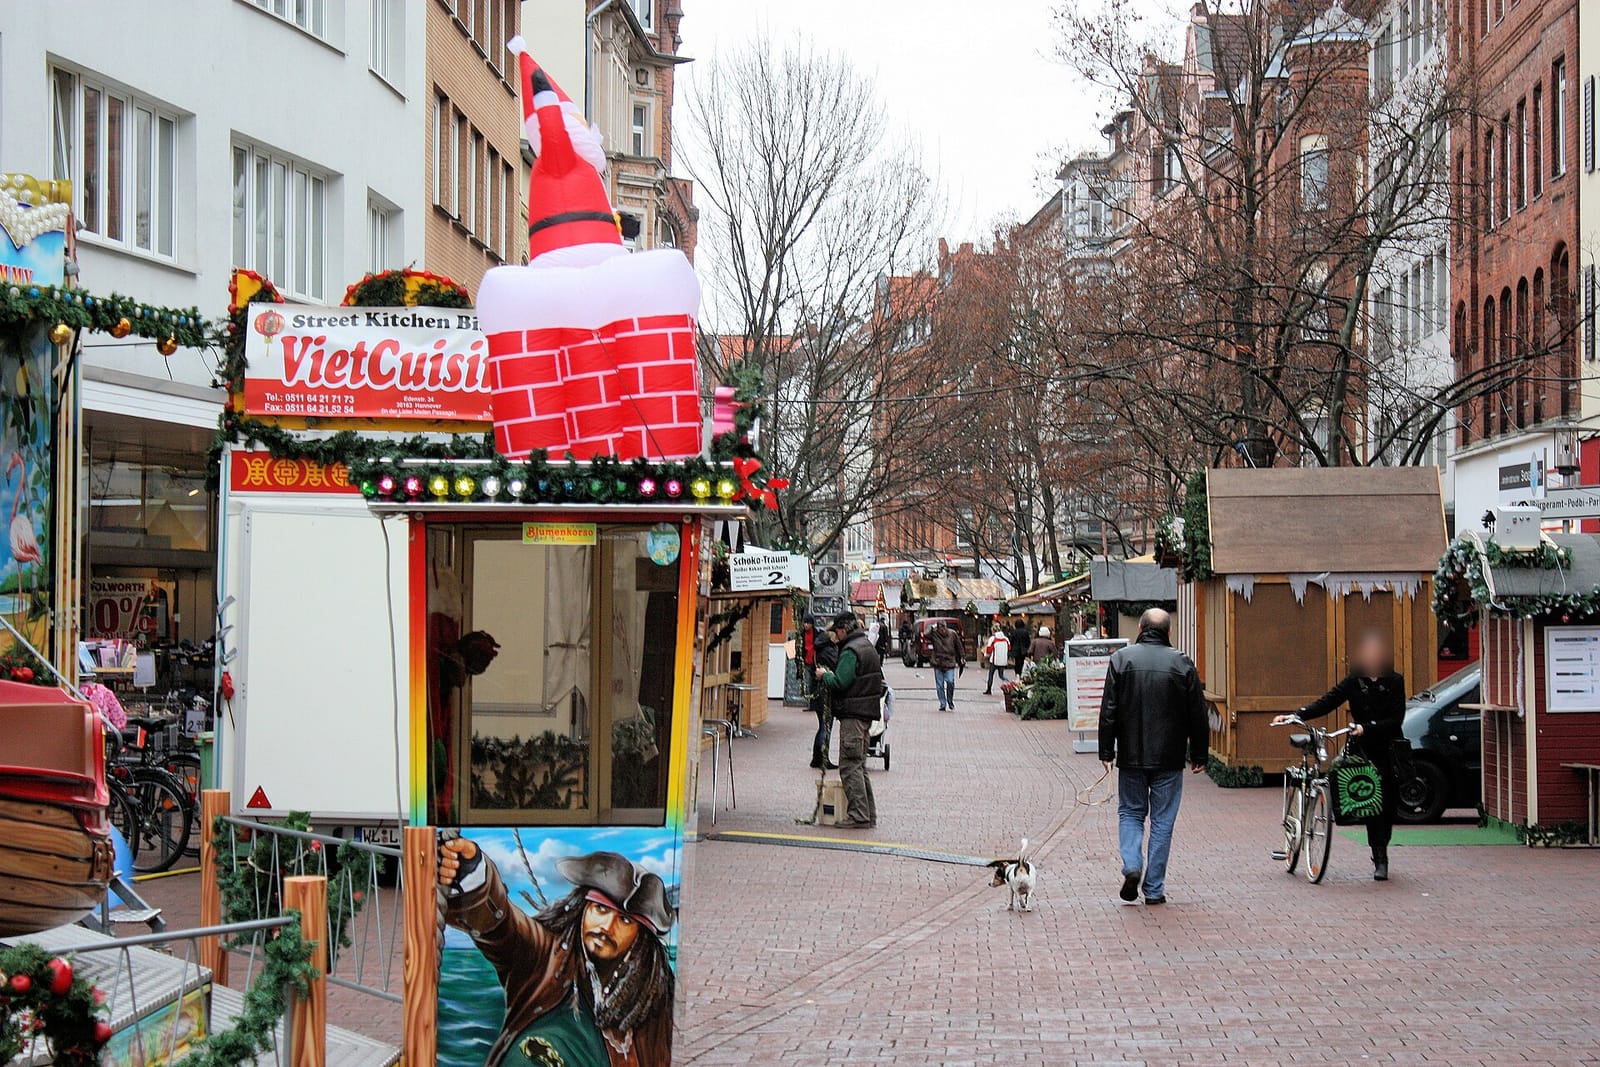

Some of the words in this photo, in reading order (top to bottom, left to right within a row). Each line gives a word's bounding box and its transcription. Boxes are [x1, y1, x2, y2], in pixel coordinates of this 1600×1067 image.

[292, 314, 359, 328] Street
[365, 312, 450, 329] Kitchen
[456, 315, 482, 331] Bi
[265, 392, 283, 402] Tel.:
[285, 393, 304, 402] 0511
[306, 394, 317, 402] 64
[319, 394, 329, 403] 21
[331, 394, 342, 403] 71
[344, 395, 354, 404] 73
[264, 402, 283, 412] Fax:
[285, 403, 304, 412] 0511
[306, 404, 317, 413] 64
[319, 404, 329, 413] 21
[331, 404, 342, 413] 52
[733, 556, 788, 565] Schoko-Traum
[768, 571, 783, 585] 2
[90, 596, 153, 634] 0%
[363, 829, 380, 843] WL
